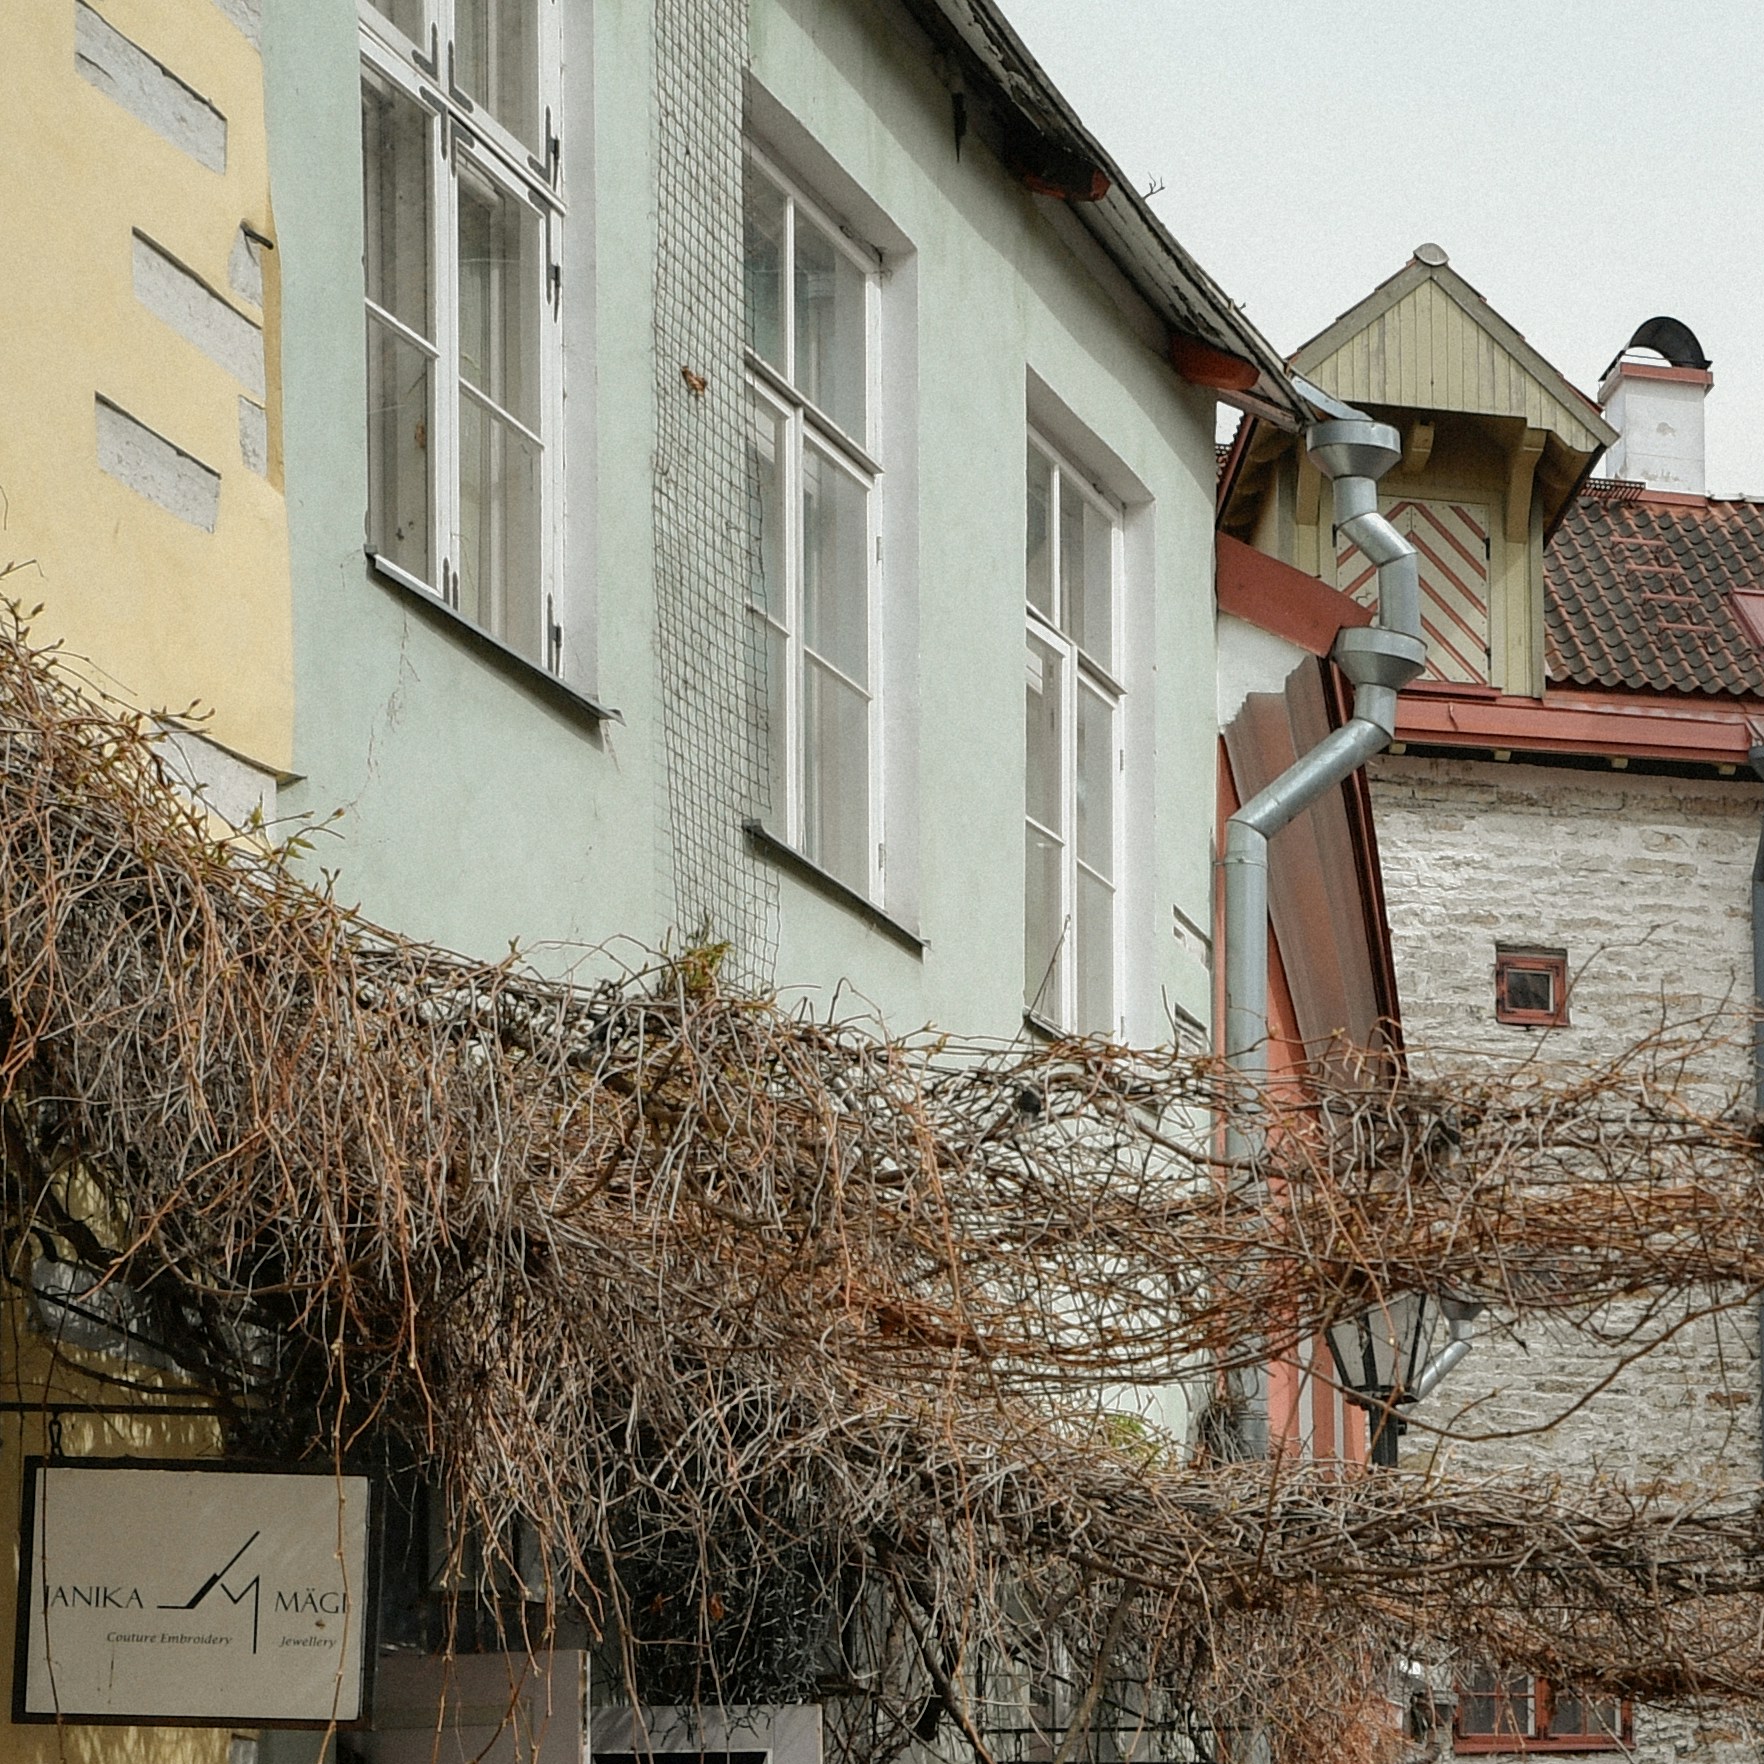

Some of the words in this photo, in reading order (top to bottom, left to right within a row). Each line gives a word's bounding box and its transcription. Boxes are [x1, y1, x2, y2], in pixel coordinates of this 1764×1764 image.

[106, 1631, 157, 1645] Couture
[160, 1632, 232, 1647] Embroidery
[279, 1636, 337, 1650] Jewellery
